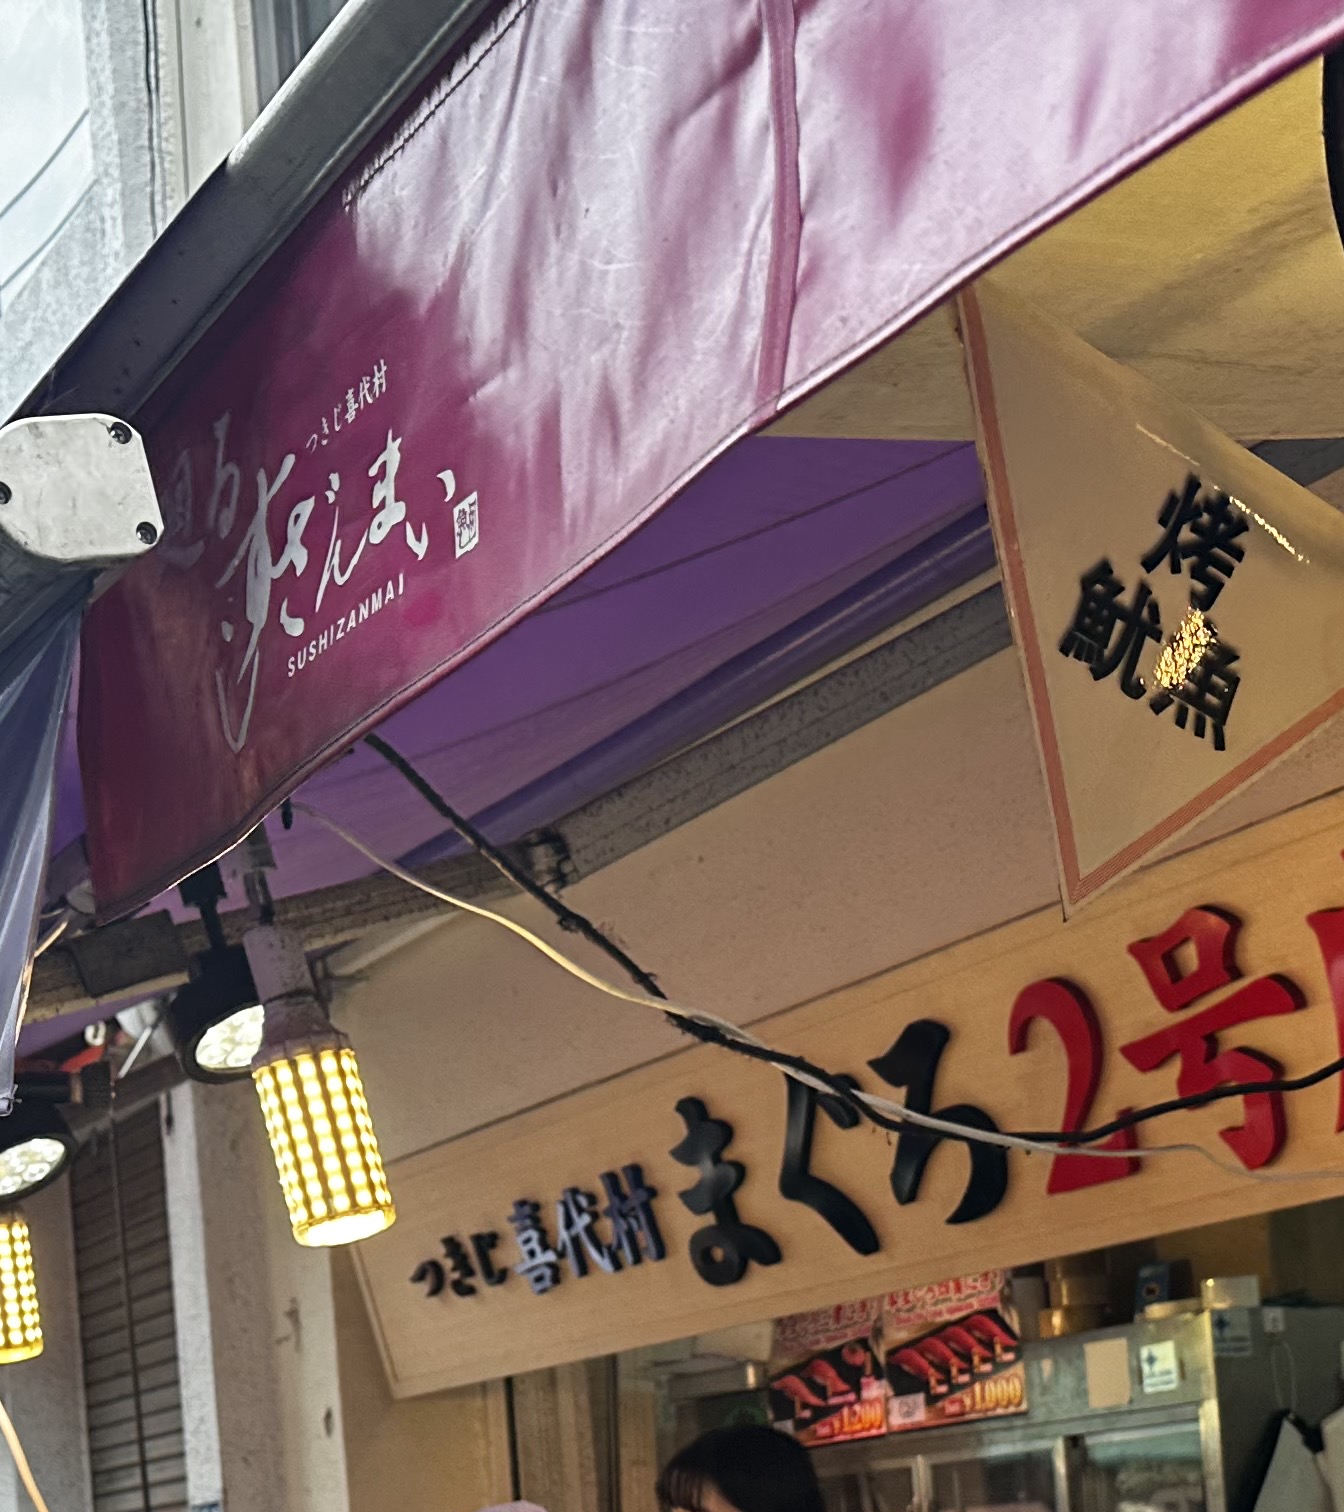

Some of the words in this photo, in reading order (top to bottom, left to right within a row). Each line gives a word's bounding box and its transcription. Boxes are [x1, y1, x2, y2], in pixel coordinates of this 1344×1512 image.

[305, 358, 388, 453] つきじ喜代村
[1140, 470, 1250, 612] 烤
[287, 573, 405, 678] SUSHIZANMAI
[409, 1163, 666, 1296] つきじ喜代村
